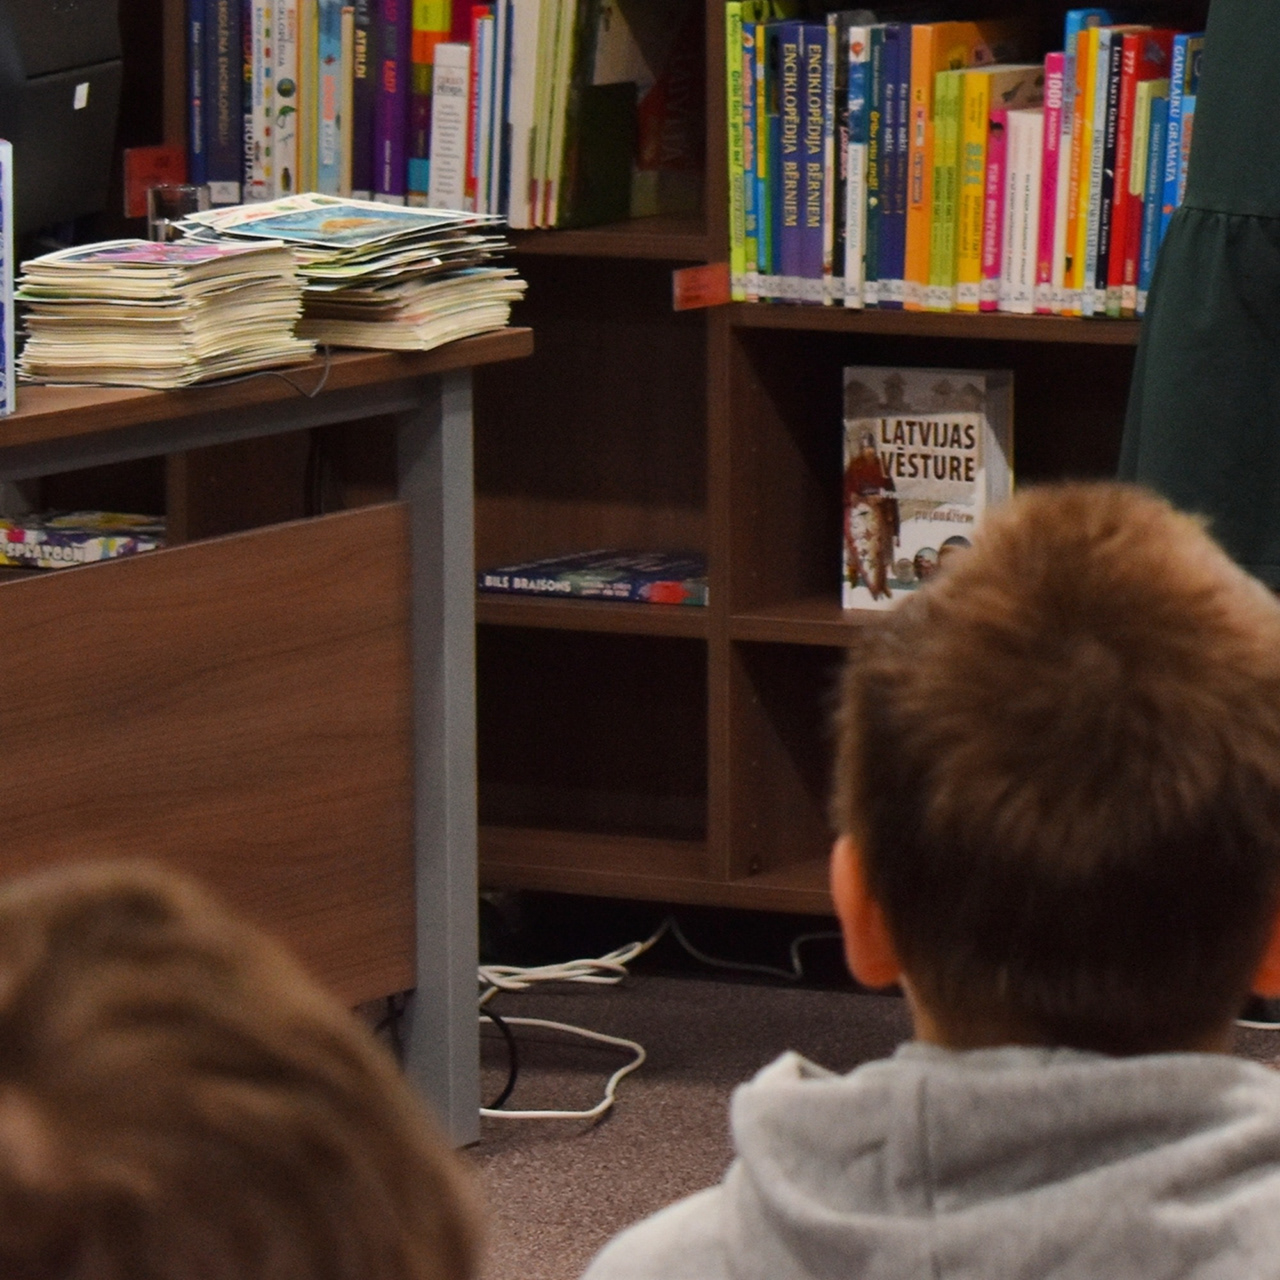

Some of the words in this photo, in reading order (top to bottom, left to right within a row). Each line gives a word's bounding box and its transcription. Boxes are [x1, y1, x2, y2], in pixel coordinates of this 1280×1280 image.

[1124, 51, 1135, 74] 777
[1169, 45, 1185, 119] GADALAIKU
[782, 43, 800, 154] ENCIKLOPĒDIJA
[804, 43, 824, 155] ENCIKLOPĒDIJA
[1048, 72, 1063, 108] 1000
[1164, 122, 1182, 183] GRĀMATA
[783, 162, 801, 227] BĒRNIEM
[806, 162, 825, 228] BĒRNIEM
[881, 418, 976, 450] LATVIJAS
[881, 447, 975, 482] VĒSTURE
[6, 542, 86, 563] SPLATOON
[484, 575, 509, 589] BILS
[513, 576, 571, 593] BRAISONS
